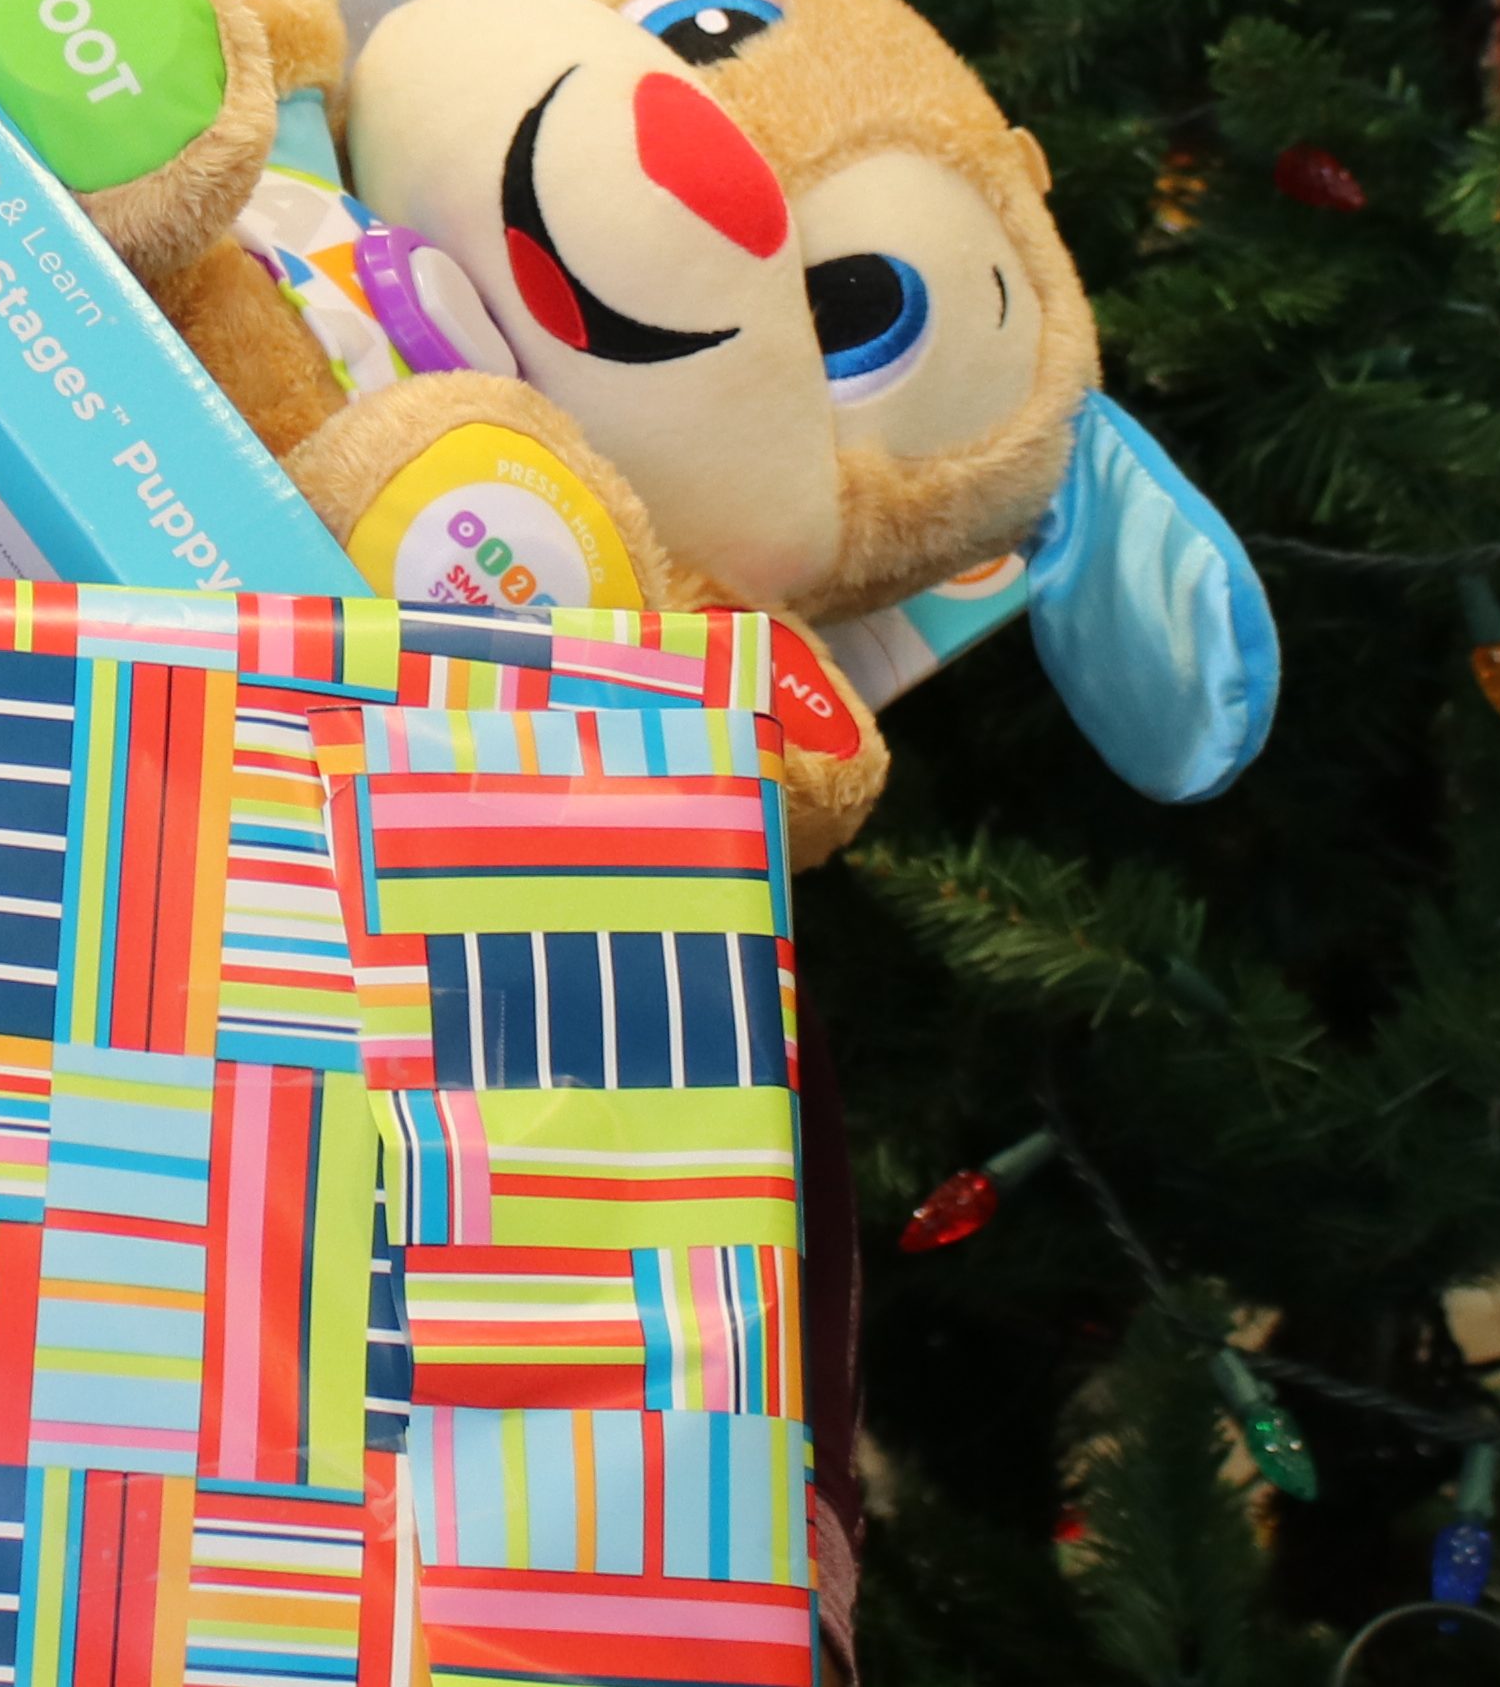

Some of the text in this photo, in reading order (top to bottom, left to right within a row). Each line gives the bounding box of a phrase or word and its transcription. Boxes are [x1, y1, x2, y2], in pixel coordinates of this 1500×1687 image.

[20, 228, 103, 327] Learn
[113, 438, 243, 593] Puppy
[495, 459, 561, 502] PRESS
[570, 514, 605, 585] HOLD
[446, 563, 494, 606] SMA
[771, 662, 835, 719] ND
